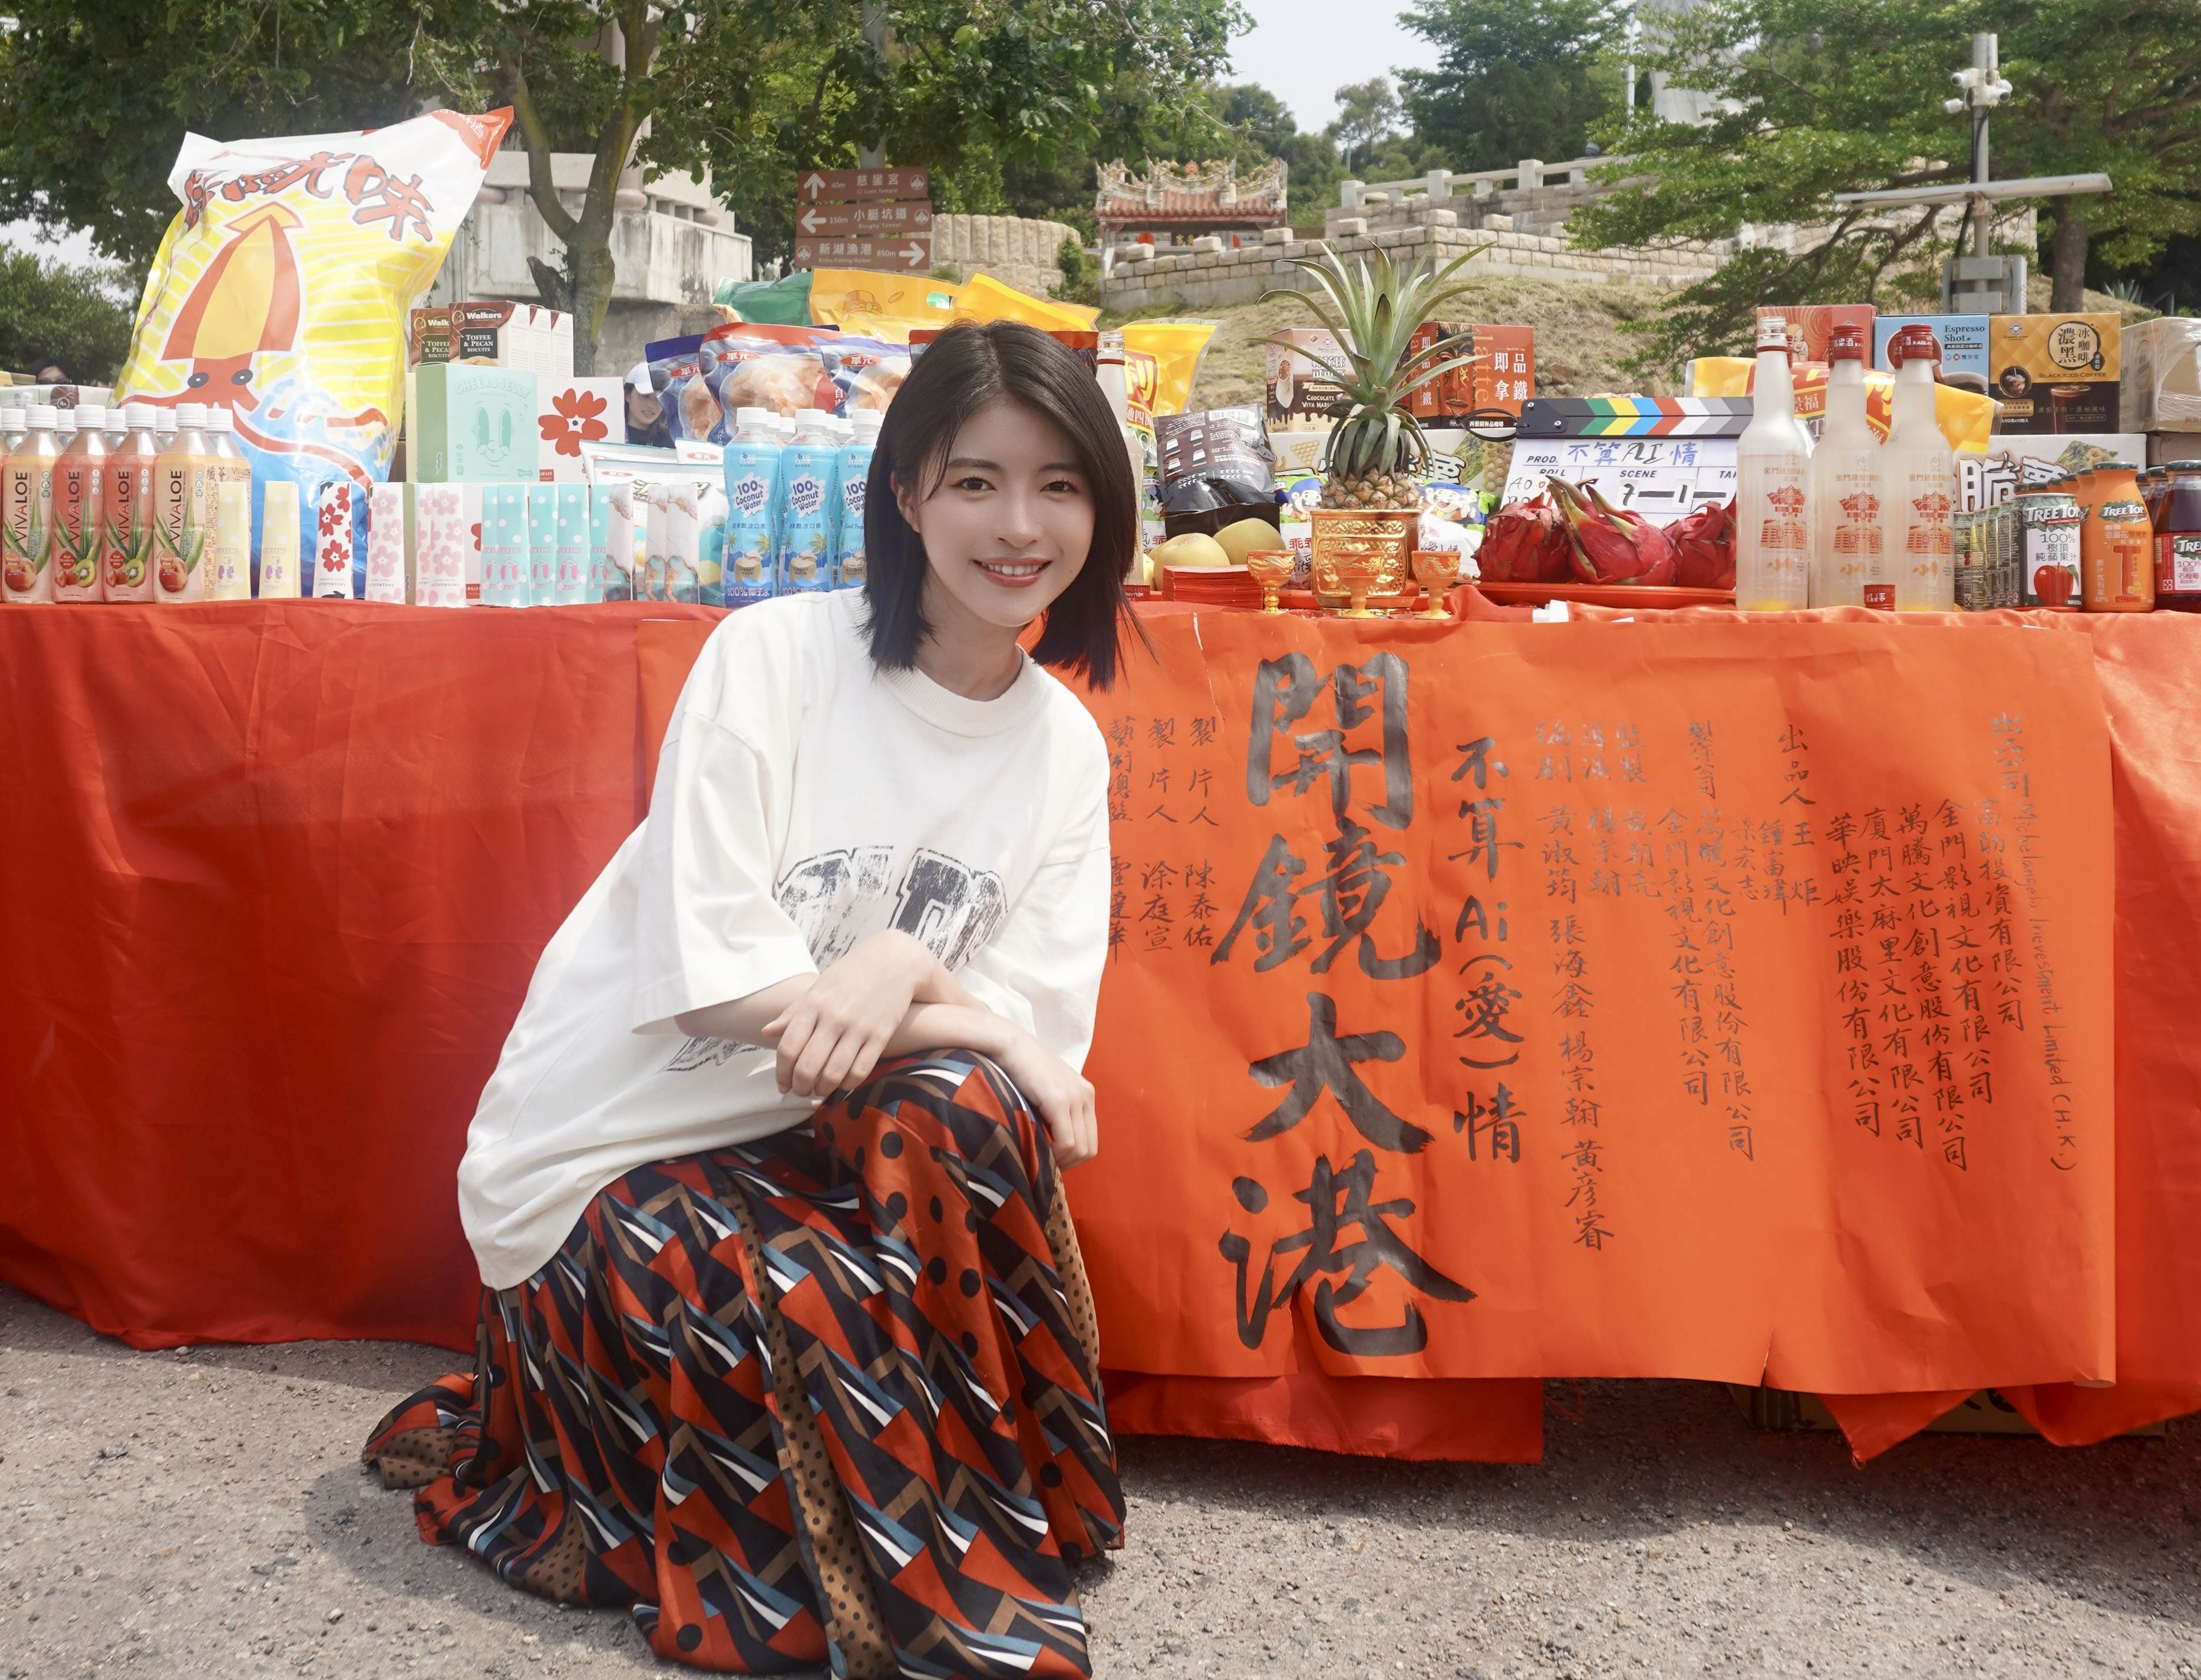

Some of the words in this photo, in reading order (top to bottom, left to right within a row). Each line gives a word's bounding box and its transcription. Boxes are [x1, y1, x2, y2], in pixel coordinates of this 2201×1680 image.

[857, 174, 899, 186] 慈鑾宮
[854, 208, 907, 221] 小艇坑道
[819, 243, 872, 256] 新湖漁港
[466, 312, 502, 320] Walkers
[1945, 325, 1985, 333] Espresso
[2058, 328, 2076, 364] 濃黑
[2078, 328, 2090, 363] 冰咖啡
[727, 352, 751, 361] 華元
[850, 356, 874, 364] 華元
[1494, 352, 1526, 373] 即品
[1495, 379, 1528, 401] 拿鐵
[737, 480, 764, 496] 100%
[793, 480, 819, 496] 100%
[846, 480, 866, 496] 100
[735, 490, 764, 506] Coconut
[744, 499, 762, 511] Water
[791, 490, 819, 506] Coconut
[798, 499, 817, 511] Water
[846, 494, 866, 506] Cocon
[2025, 506, 2061, 523] TREE
[2102, 507, 2127, 517] TREE
[2040, 533, 2075, 543] 100%
[2047, 543, 2069, 553] 樹頂
[2035, 553, 2077, 562] 純蘋果汁
[1147, 717, 1179, 824] 製片人
[1188, 715, 1220, 827] 製片人
[1778, 724, 1817, 806] 出品人
[1183, 859, 1220, 948] 陳泰佑
[1658, 807, 1710, 1106] 金門影視文化有限公司
[1933, 798, 1993, 1104] 金門影視文化有限公司
[1823, 812, 1880, 1138] 華映娛樂股份有限公司
[1858, 807, 1924, 1150] 廈門太麻里文化有限公司
[1895, 803, 1967, 1172] 萬騰文化創意股份有限公司
[1212, 651, 1477, 1358] 開鏡大港
[2042, 1024, 2073, 1085] Limited
[1559, 1031, 1603, 1129] 楊宗翰
